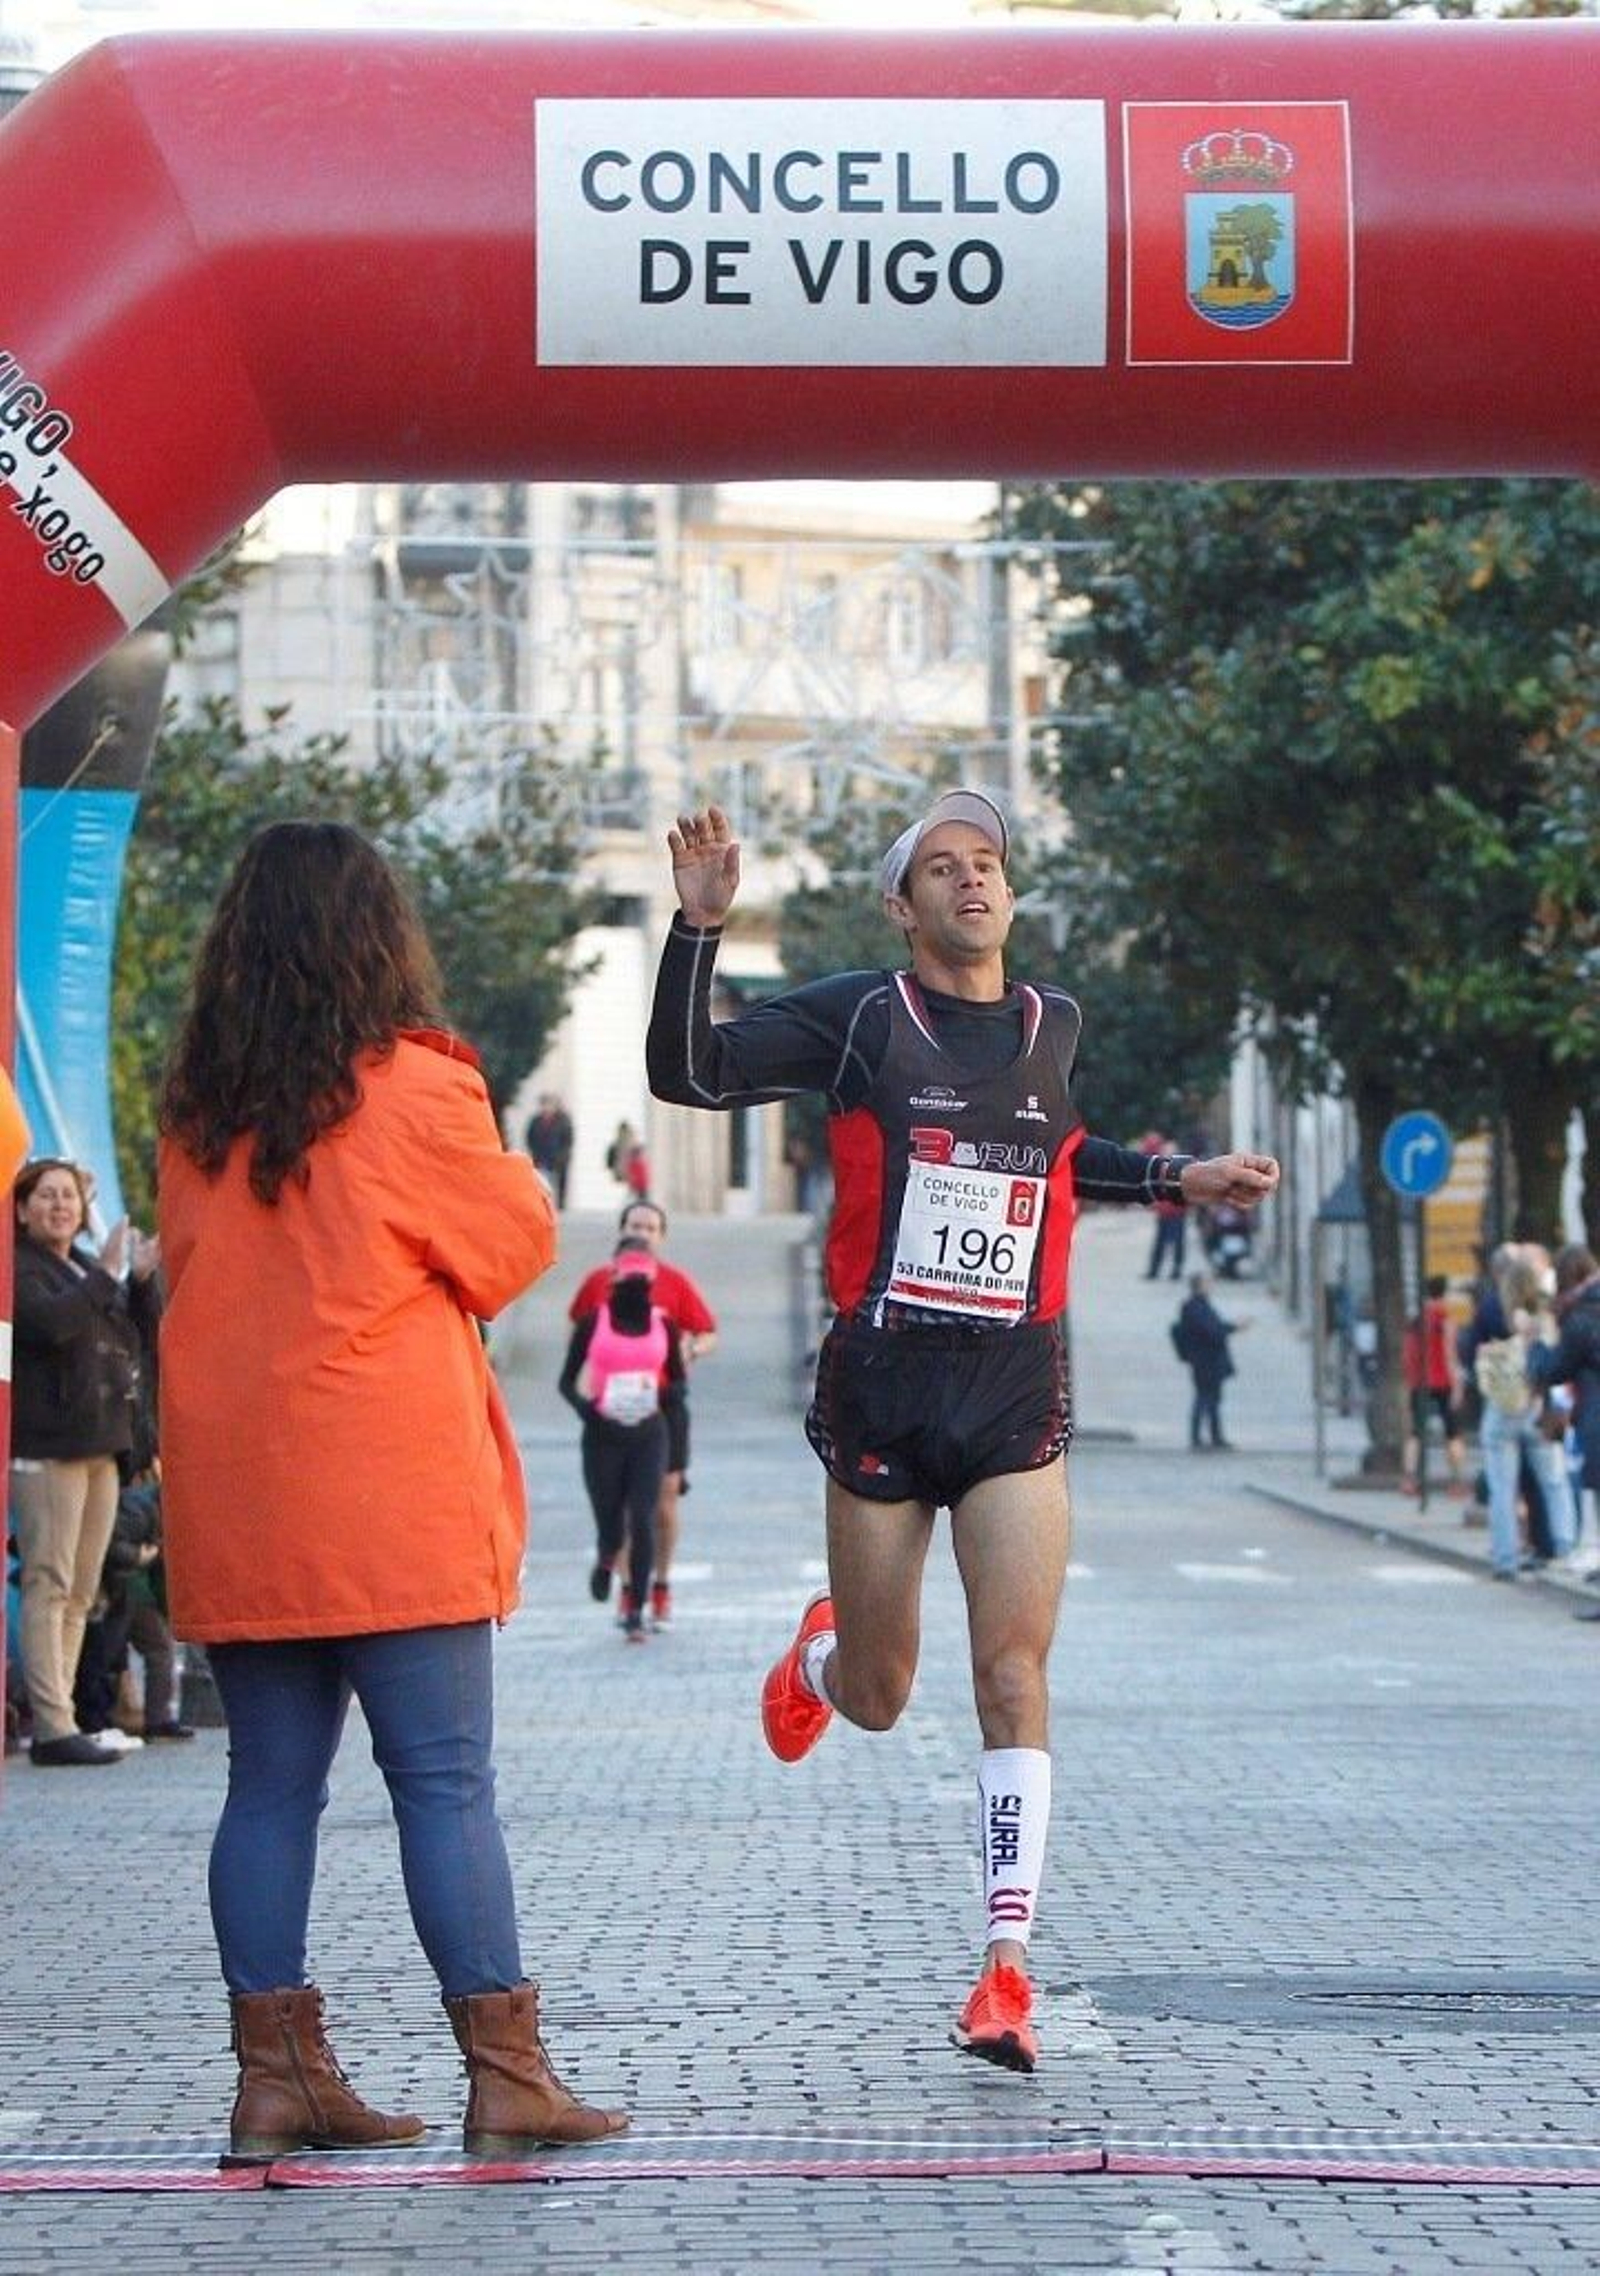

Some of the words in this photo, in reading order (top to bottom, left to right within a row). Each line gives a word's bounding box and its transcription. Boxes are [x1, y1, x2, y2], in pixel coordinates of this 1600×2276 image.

[580, 149, 1061, 214] CONCELLO
[639, 238, 752, 306] DE
[788, 237, 1006, 306] VIGO
[16, 484, 105, 582] xogo
[923, 1176, 999, 1199] CONCELLO
[929, 1193, 948, 1207] DE
[954, 1197, 989, 1212] VIGO
[897, 1261, 914, 1275] 53
[917, 1266, 982, 1287] CARREIRA
[985, 1276, 1002, 1289] DO
[932, 1224, 1017, 1275] 196
[989, 1794, 1022, 1876] SURAL
